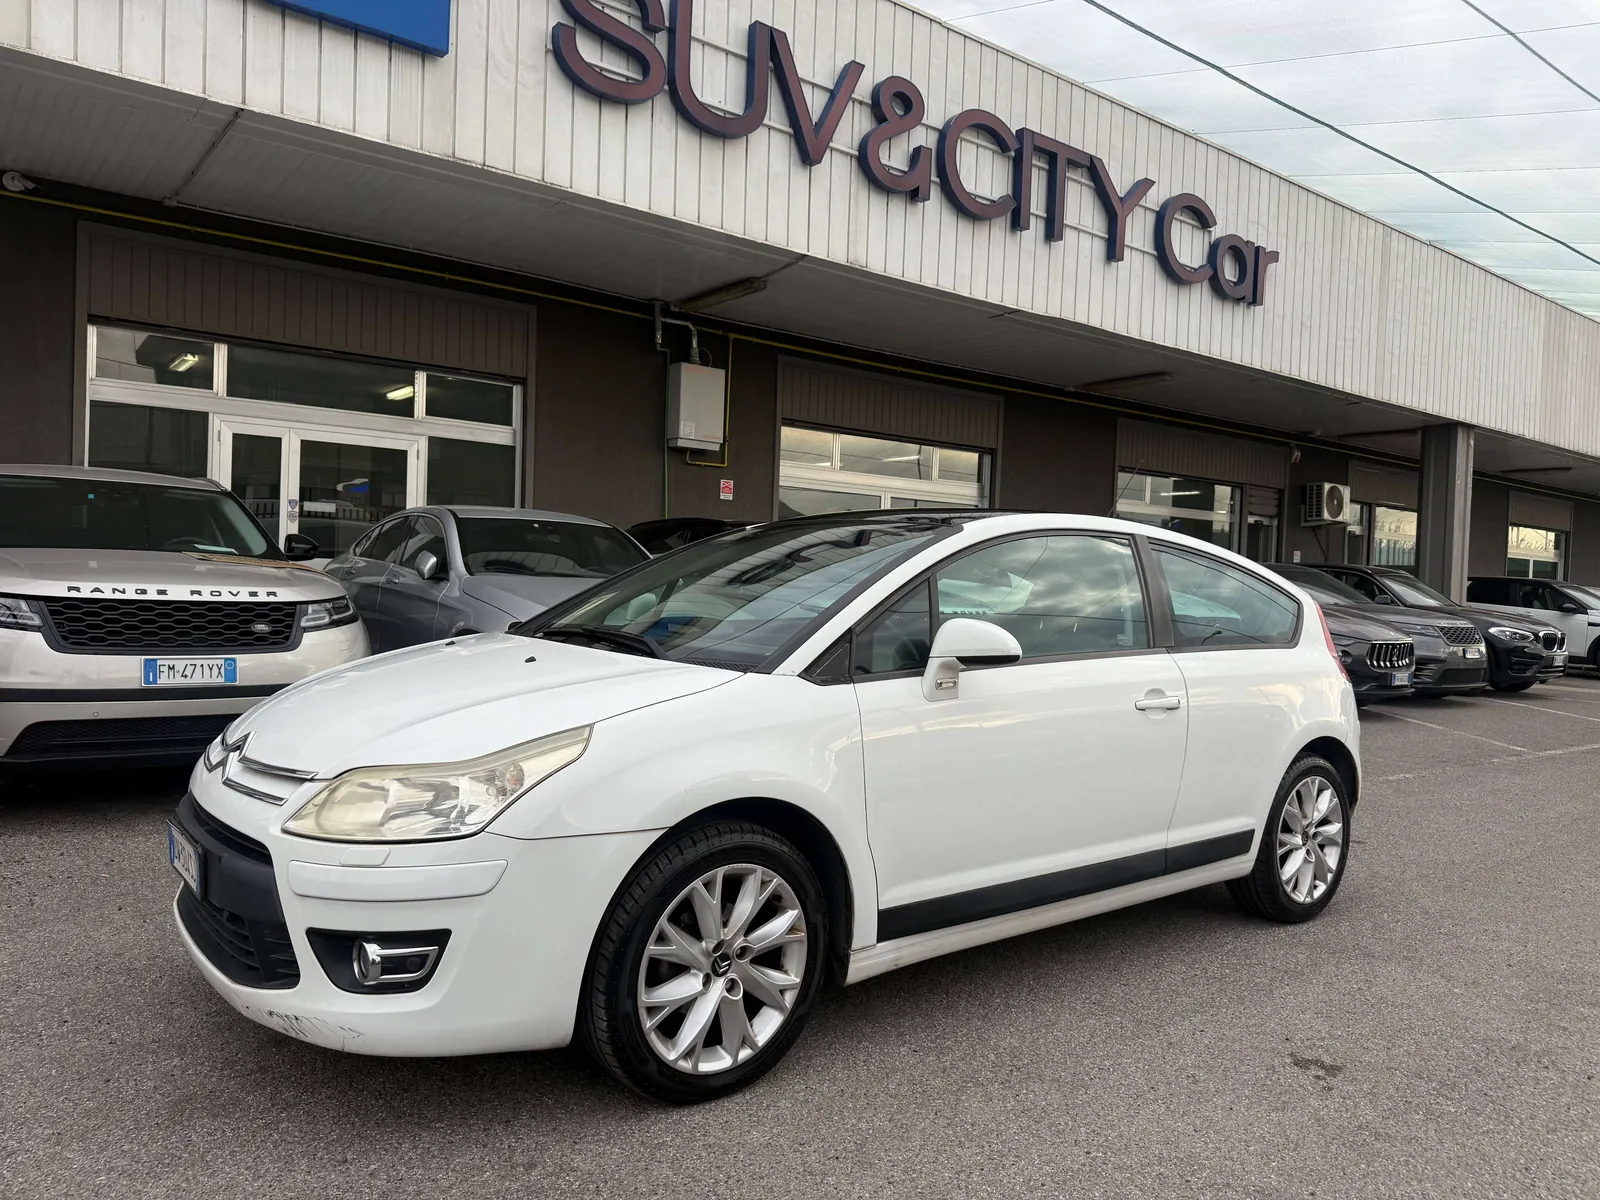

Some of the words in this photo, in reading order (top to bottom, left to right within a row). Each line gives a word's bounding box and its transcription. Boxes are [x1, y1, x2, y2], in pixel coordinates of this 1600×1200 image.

[1155, 192, 1279, 307] Car
[67, 585, 169, 596] RANGE
[190, 589, 279, 597] ROVER
